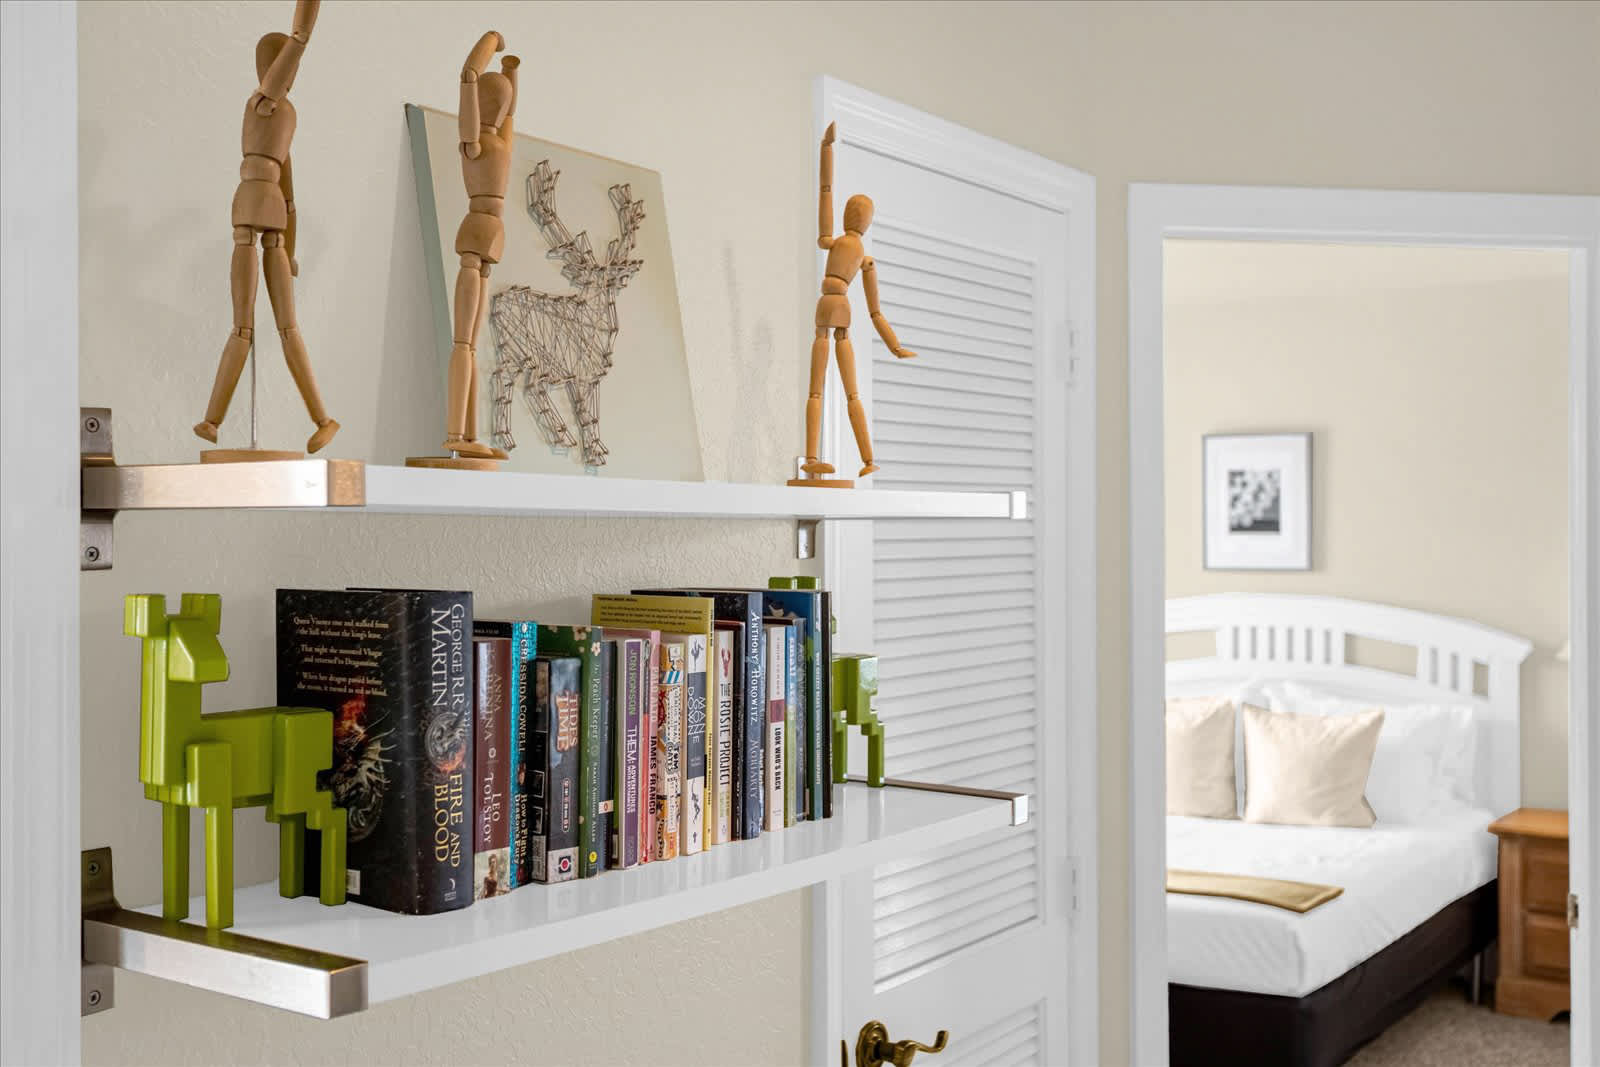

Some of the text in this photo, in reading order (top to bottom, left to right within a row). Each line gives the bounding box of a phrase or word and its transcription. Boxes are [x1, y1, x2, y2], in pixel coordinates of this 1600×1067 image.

[432, 607, 451, 707] MARTIN
[451, 603, 465, 673] GEORGE
[750, 610, 761, 726] ANTHONY HOROWITZ
[484, 647, 496, 742] KARENINA
[494, 673, 503, 713] ANNA
[519, 638, 528, 753] CRESSIDA COWELL
[592, 677, 601, 704] Peach
[628, 649, 638, 716] JON RONSON
[556, 690, 570, 752] TIME
[568, 694, 579, 748] TIDES
[590, 708, 601, 738] Keeper
[626, 725, 638, 764] THEM:
[720, 700, 731, 736] ROSIE
[648, 735, 658, 816] JAMES FRANCO
[720, 740, 731, 785] PROJECT
[749, 739, 760, 798] MORIARTY
[774, 727, 782, 792] LOOK WHO'S BACK
[434, 784, 449, 863] BLOOD
[450, 773, 463, 868] FIRE AND
[483, 772, 494, 844] TOLSTOY
[491, 792, 502, 823] LEO
